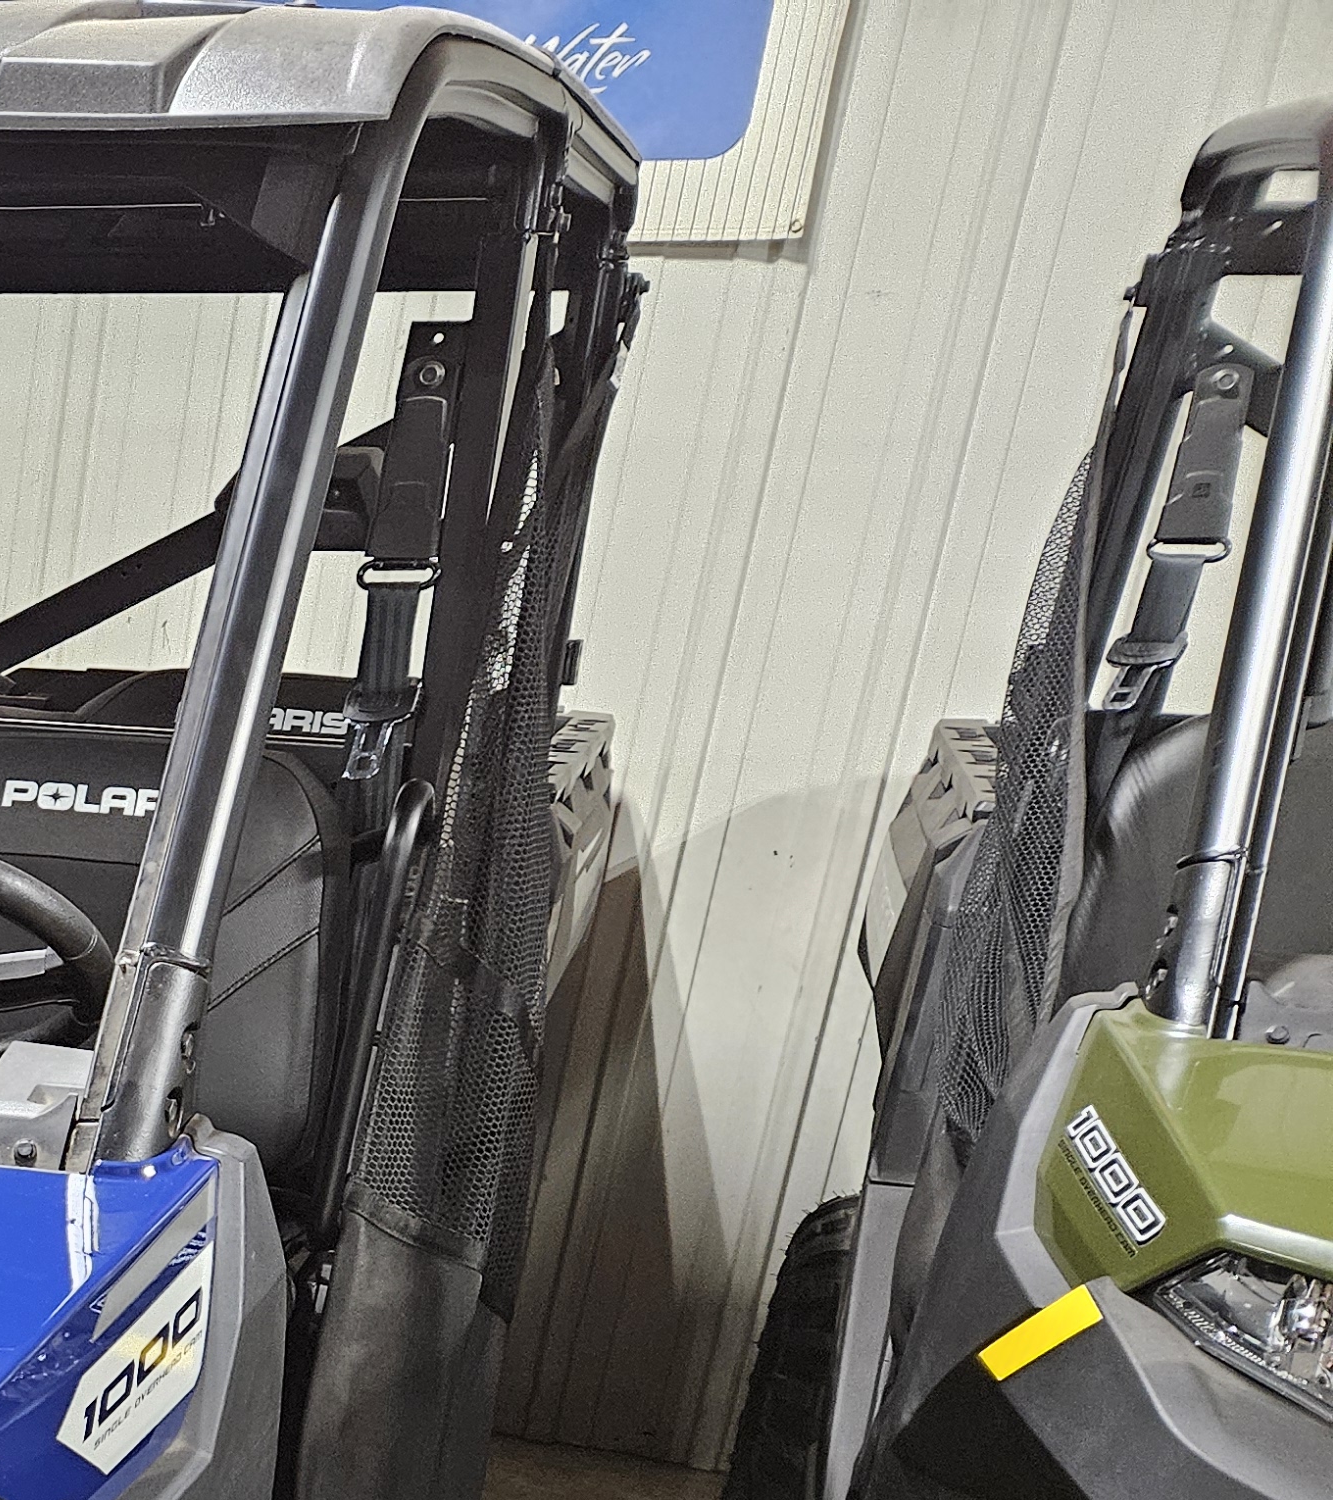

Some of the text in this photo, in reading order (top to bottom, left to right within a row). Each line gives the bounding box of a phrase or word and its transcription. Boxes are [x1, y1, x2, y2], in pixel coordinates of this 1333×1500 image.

[1065, 1104, 1167, 1247] 1000
[82, 1285, 203, 1444] 1000
[93, 1406, 132, 1451] SINGLE
[134, 1352, 182, 1409] OVERHEAD
